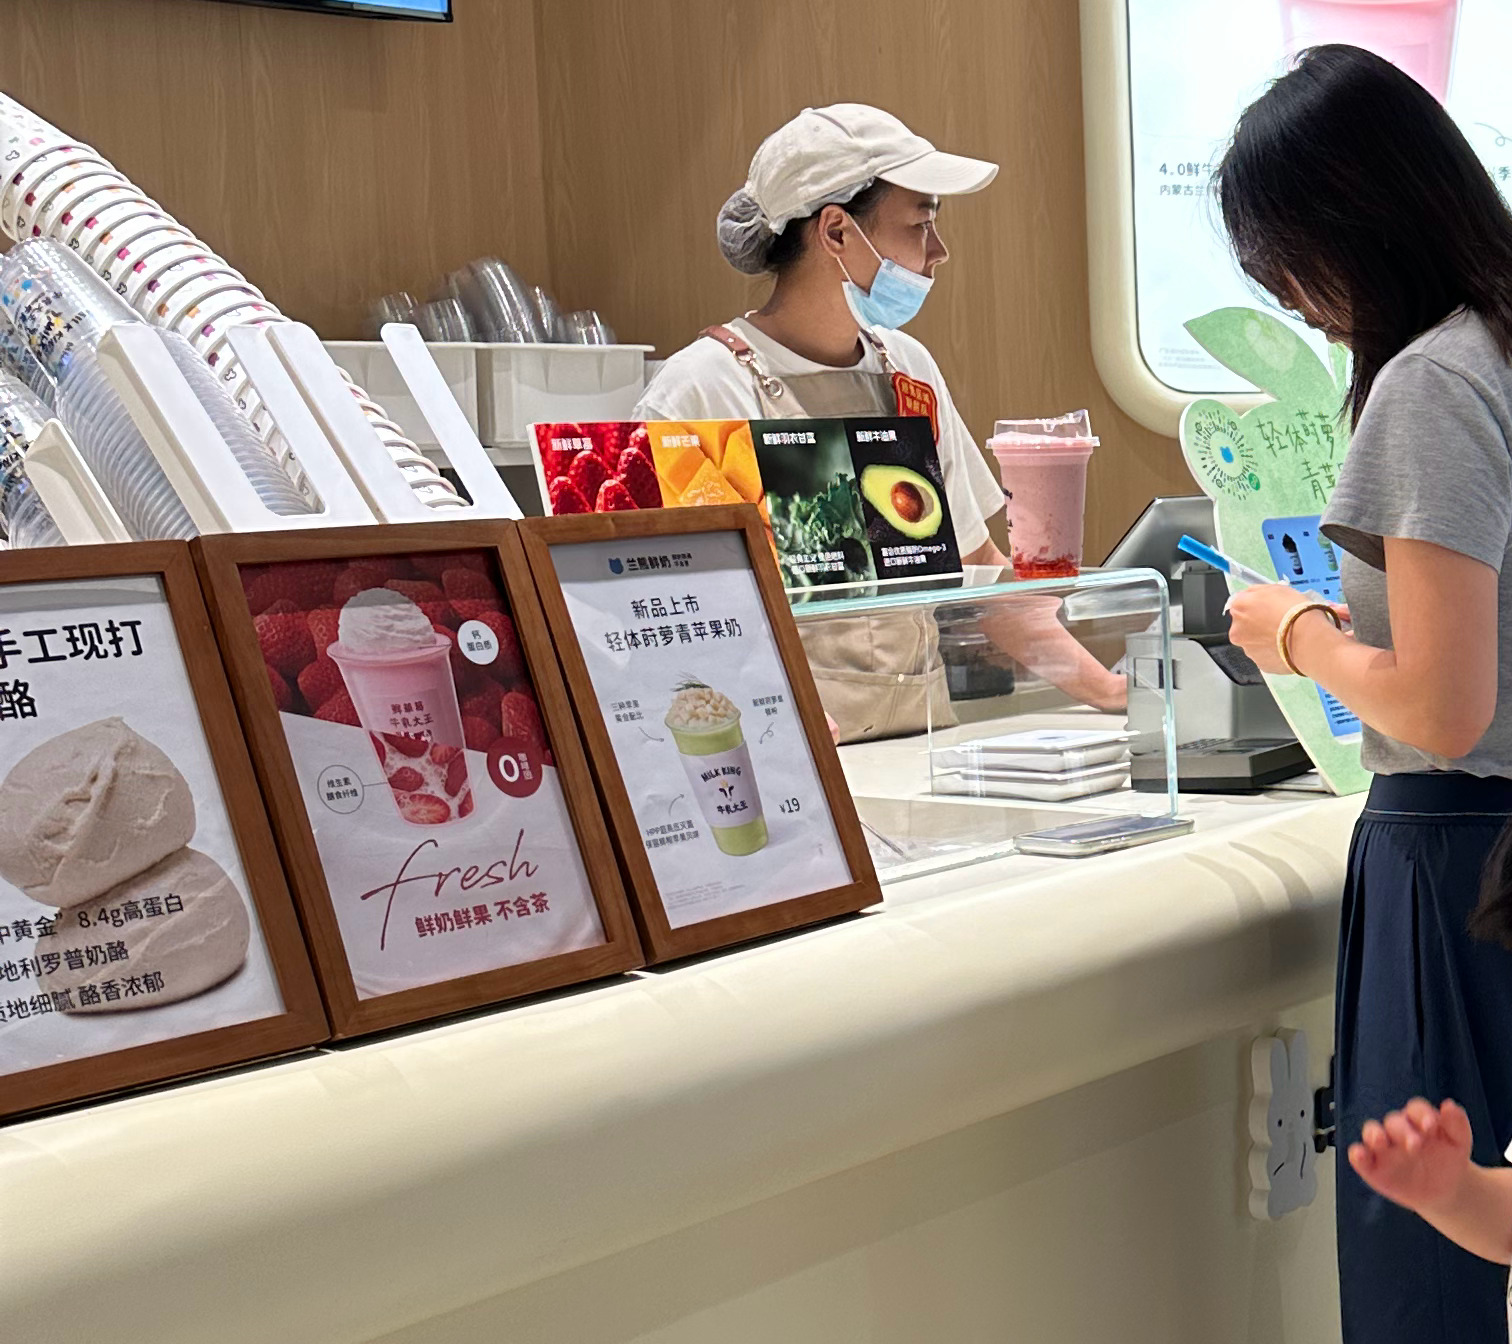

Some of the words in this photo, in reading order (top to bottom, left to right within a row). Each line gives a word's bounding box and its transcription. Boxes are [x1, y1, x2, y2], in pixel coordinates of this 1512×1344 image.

[1301, 458, 1344, 505] 青苹
[630, 593, 700, 620] 新品上市
[604, 617, 743, 653] 轻体莳萝青苹果奶
[0, 678, 38, 721] 酪
[360, 827, 540, 952] fresh
[77, 893, 184, 929] 8.4g高蛋白
[414, 903, 493, 939] 鲜奶鲜果
[493, 891, 551, 921] 不含茶
[78, 970, 165, 1007] 酪香浓郁
